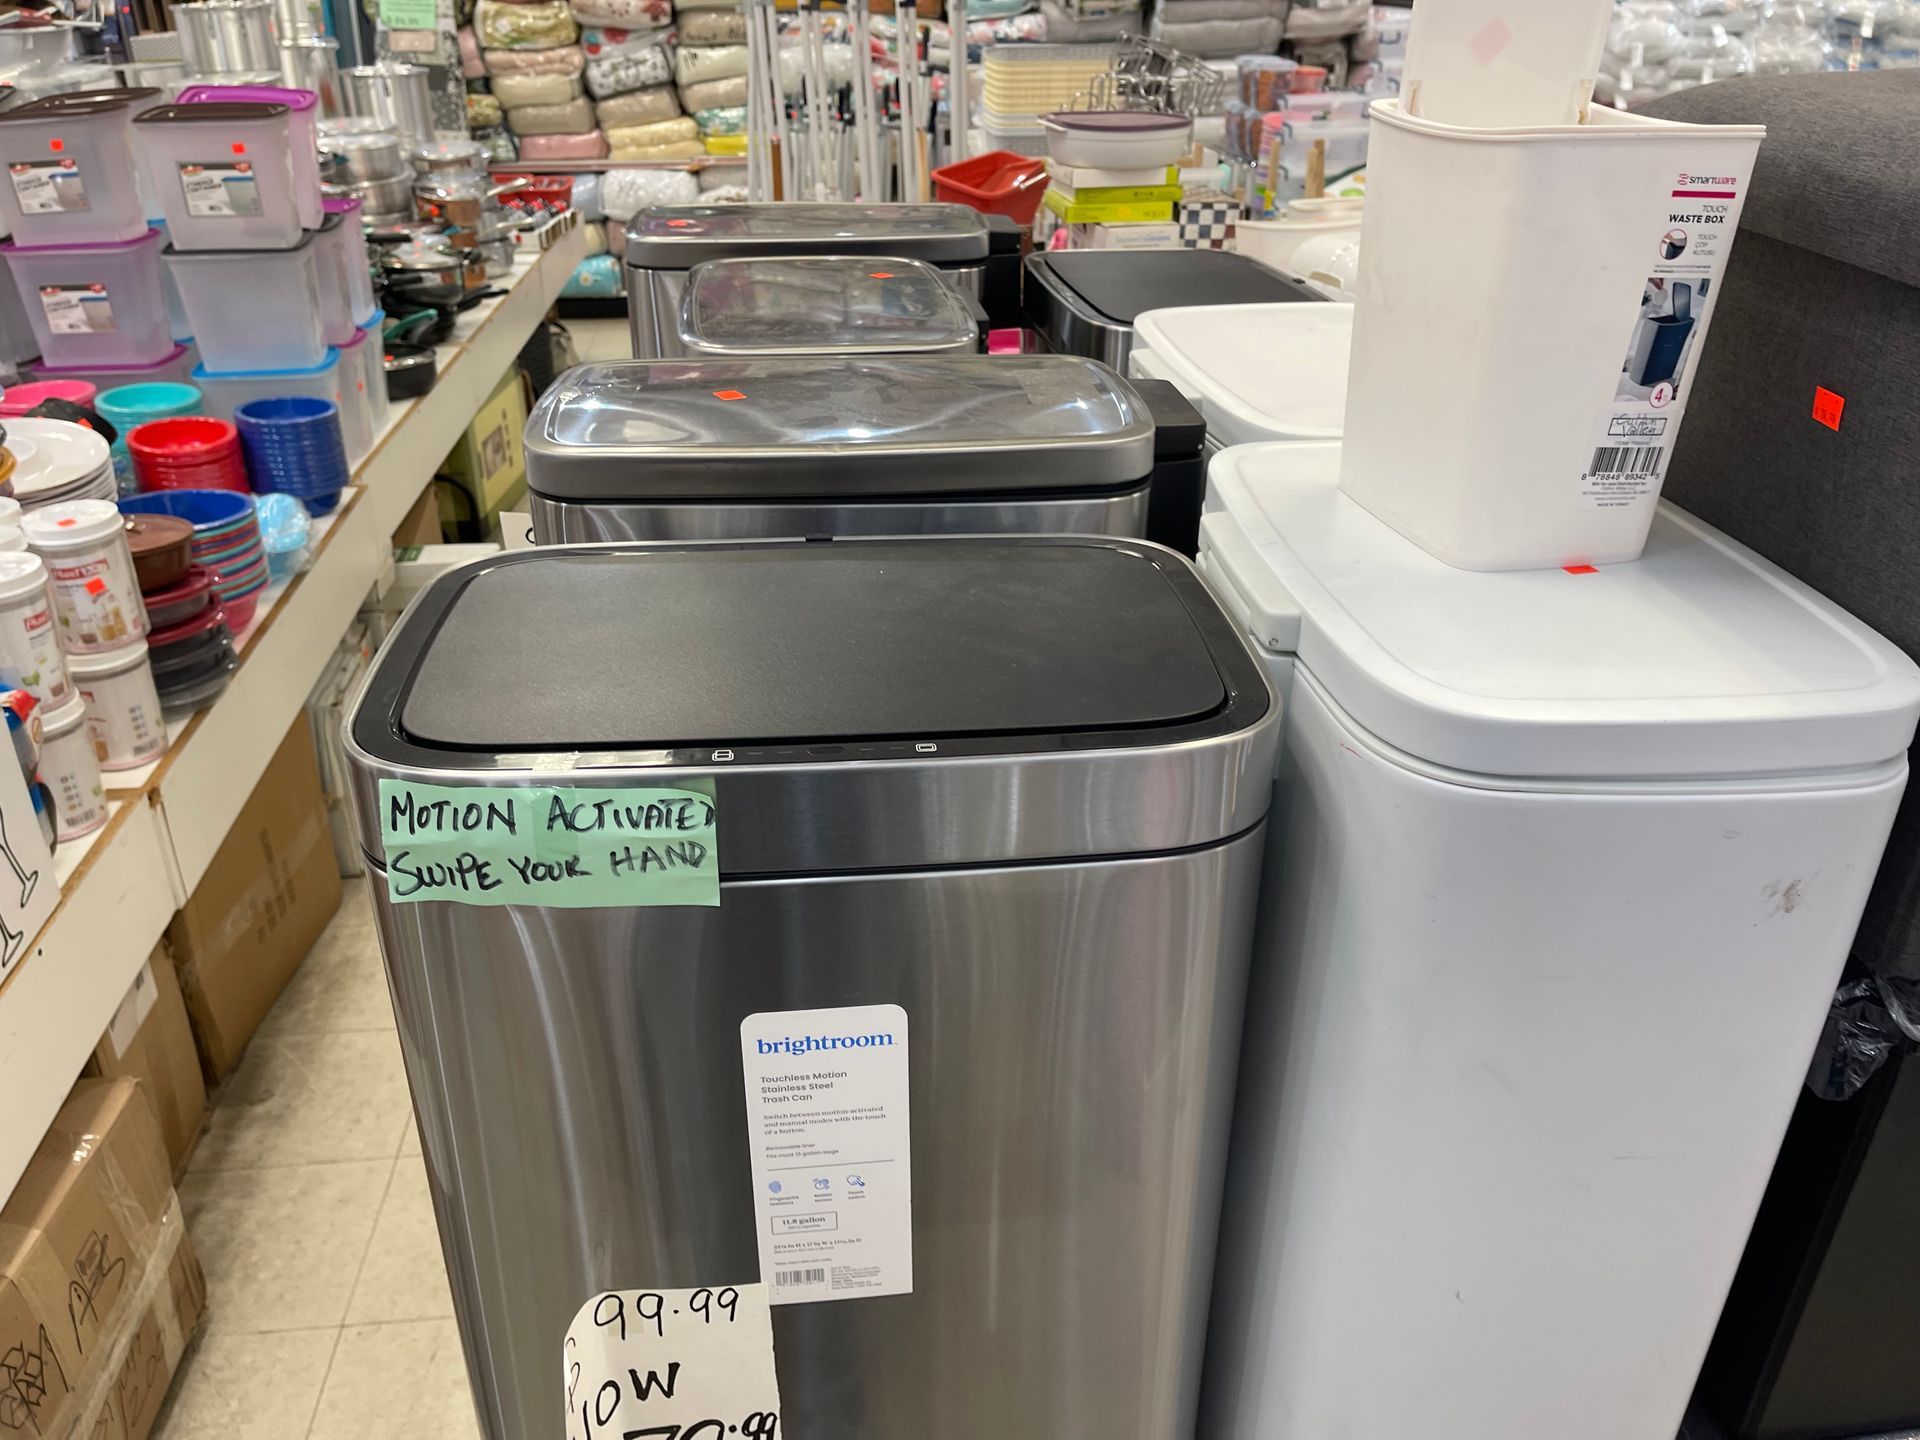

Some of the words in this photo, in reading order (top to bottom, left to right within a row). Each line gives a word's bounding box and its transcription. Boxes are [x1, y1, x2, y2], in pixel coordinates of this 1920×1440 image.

[1689, 176, 1736, 185] smartware
[1703, 205, 1728, 213] TOUCH
[1669, 214, 1703, 223] WASTE
[1704, 215, 1725, 223] BOX
[1655, 388, 1664, 402] 4
[391, 791, 517, 836] MOTION
[547, 795, 716, 833] ACTIVATED
[391, 851, 502, 896] SWIPE
[508, 855, 592, 885] YOUR
[610, 840, 707, 876] HAND
[757, 1033, 893, 1055] brightroom
[761, 1074, 810, 1083] Touchless
[813, 1071, 847, 1080] Motion
[761, 1083, 806, 1093] Stainless
[809, 1082, 833, 1090] Steel
[762, 1094, 789, 1103] Trash
[792, 1093, 812, 1102] Can
[822, 1106, 883, 1116] motion-activated
[799, 1216, 826, 1225] gallon
[594, 1287, 739, 1340] 99.99
